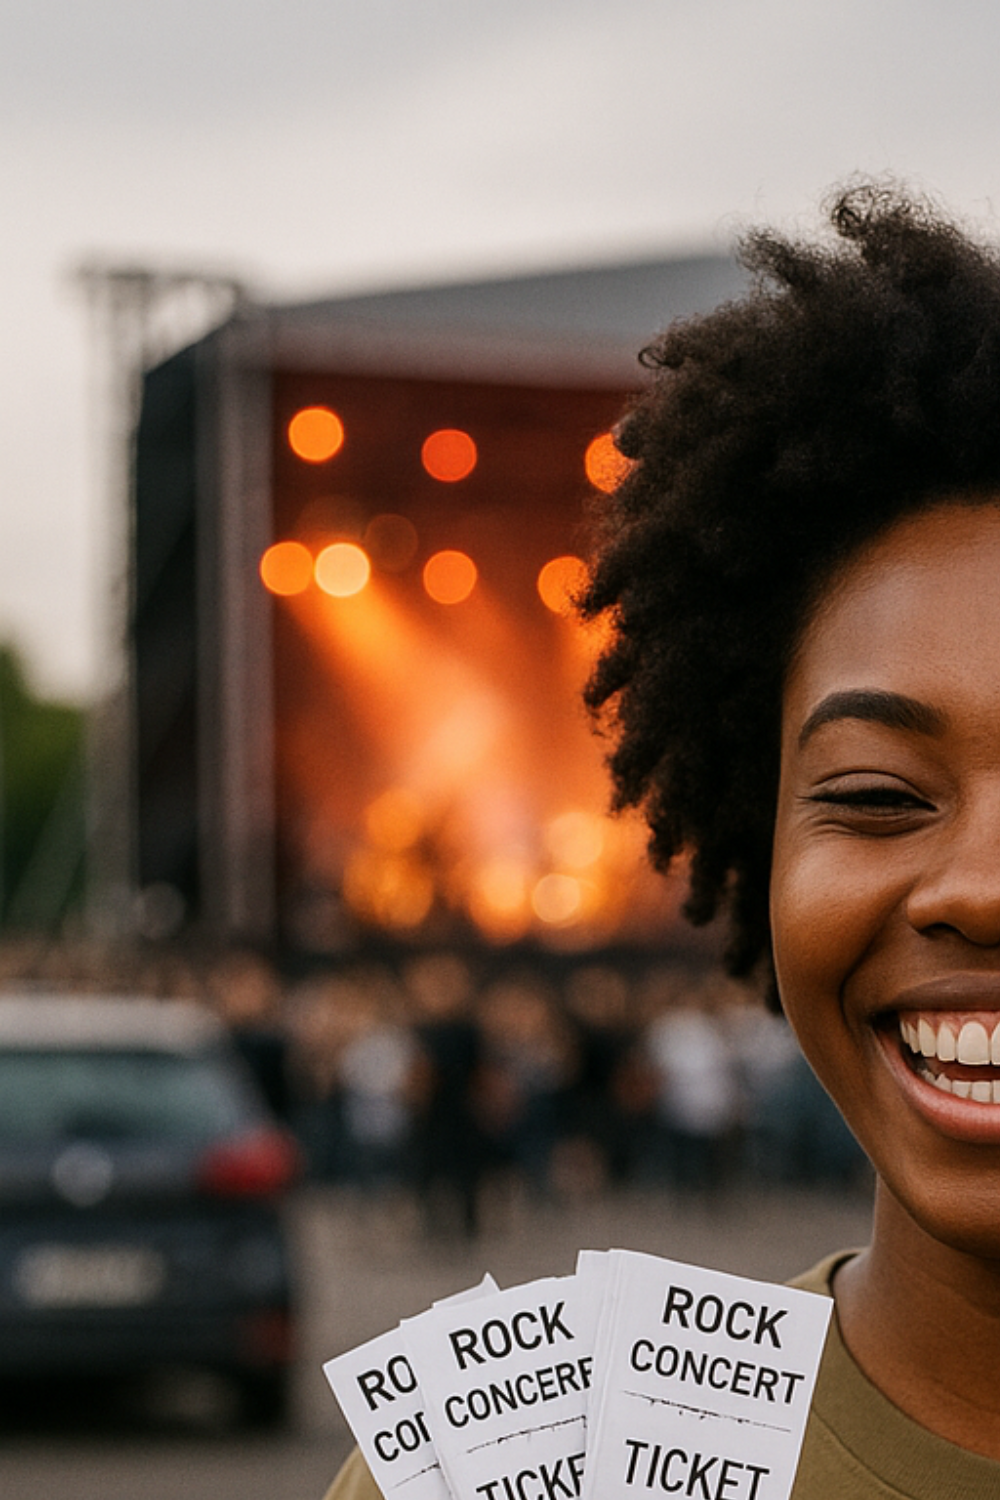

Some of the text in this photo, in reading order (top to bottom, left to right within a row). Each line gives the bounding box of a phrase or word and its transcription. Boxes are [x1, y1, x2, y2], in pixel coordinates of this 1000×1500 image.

[448, 1301, 575, 1371] ROCK
[661, 1285, 788, 1349] ROCK
[630, 1338, 806, 1405] CONCERT
